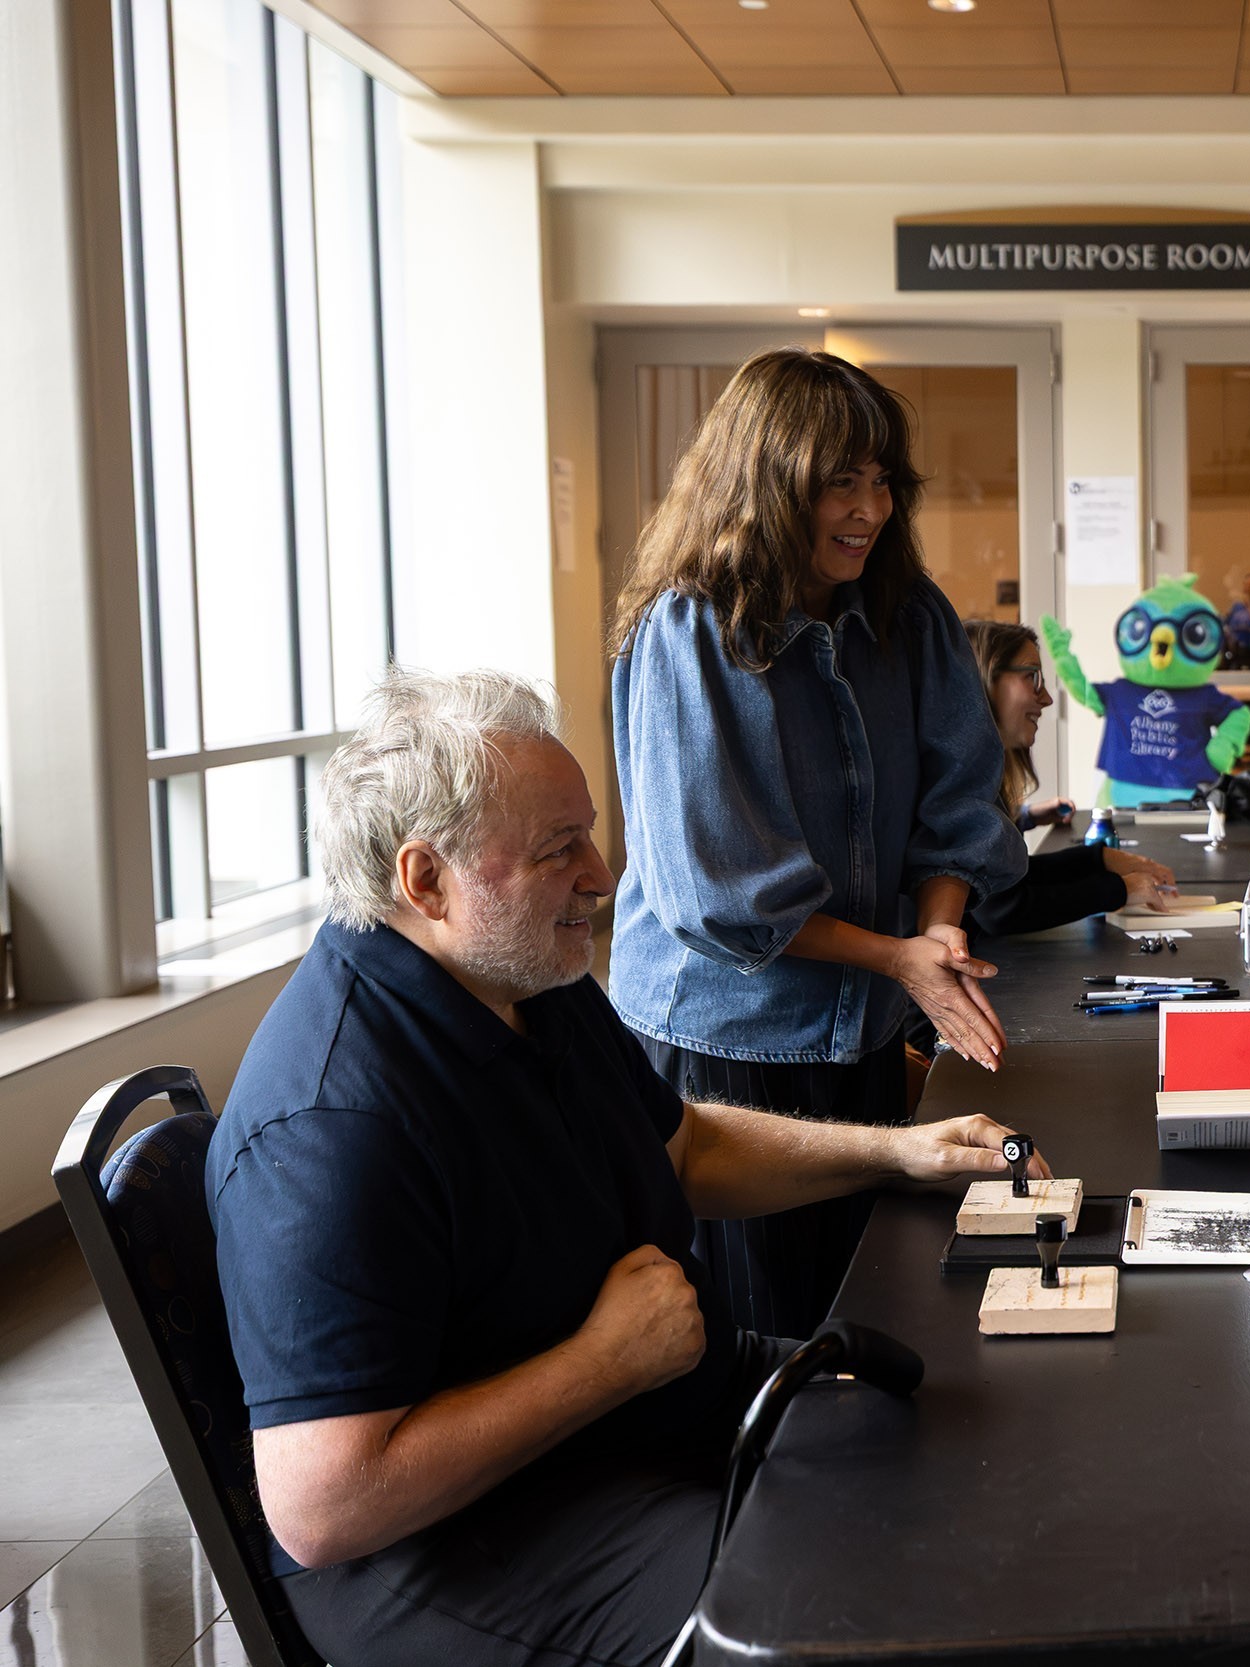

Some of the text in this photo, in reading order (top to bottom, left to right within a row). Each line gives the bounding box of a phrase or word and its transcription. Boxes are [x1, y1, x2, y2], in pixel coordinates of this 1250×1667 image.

[928, 243, 1159, 271] MULTIPURPOSE
[1130, 716, 1177, 734] Albany
[1130, 727, 1177, 746] Public
[1130, 741, 1178, 760] Library
[1007, 1146, 1016, 1156] Z
